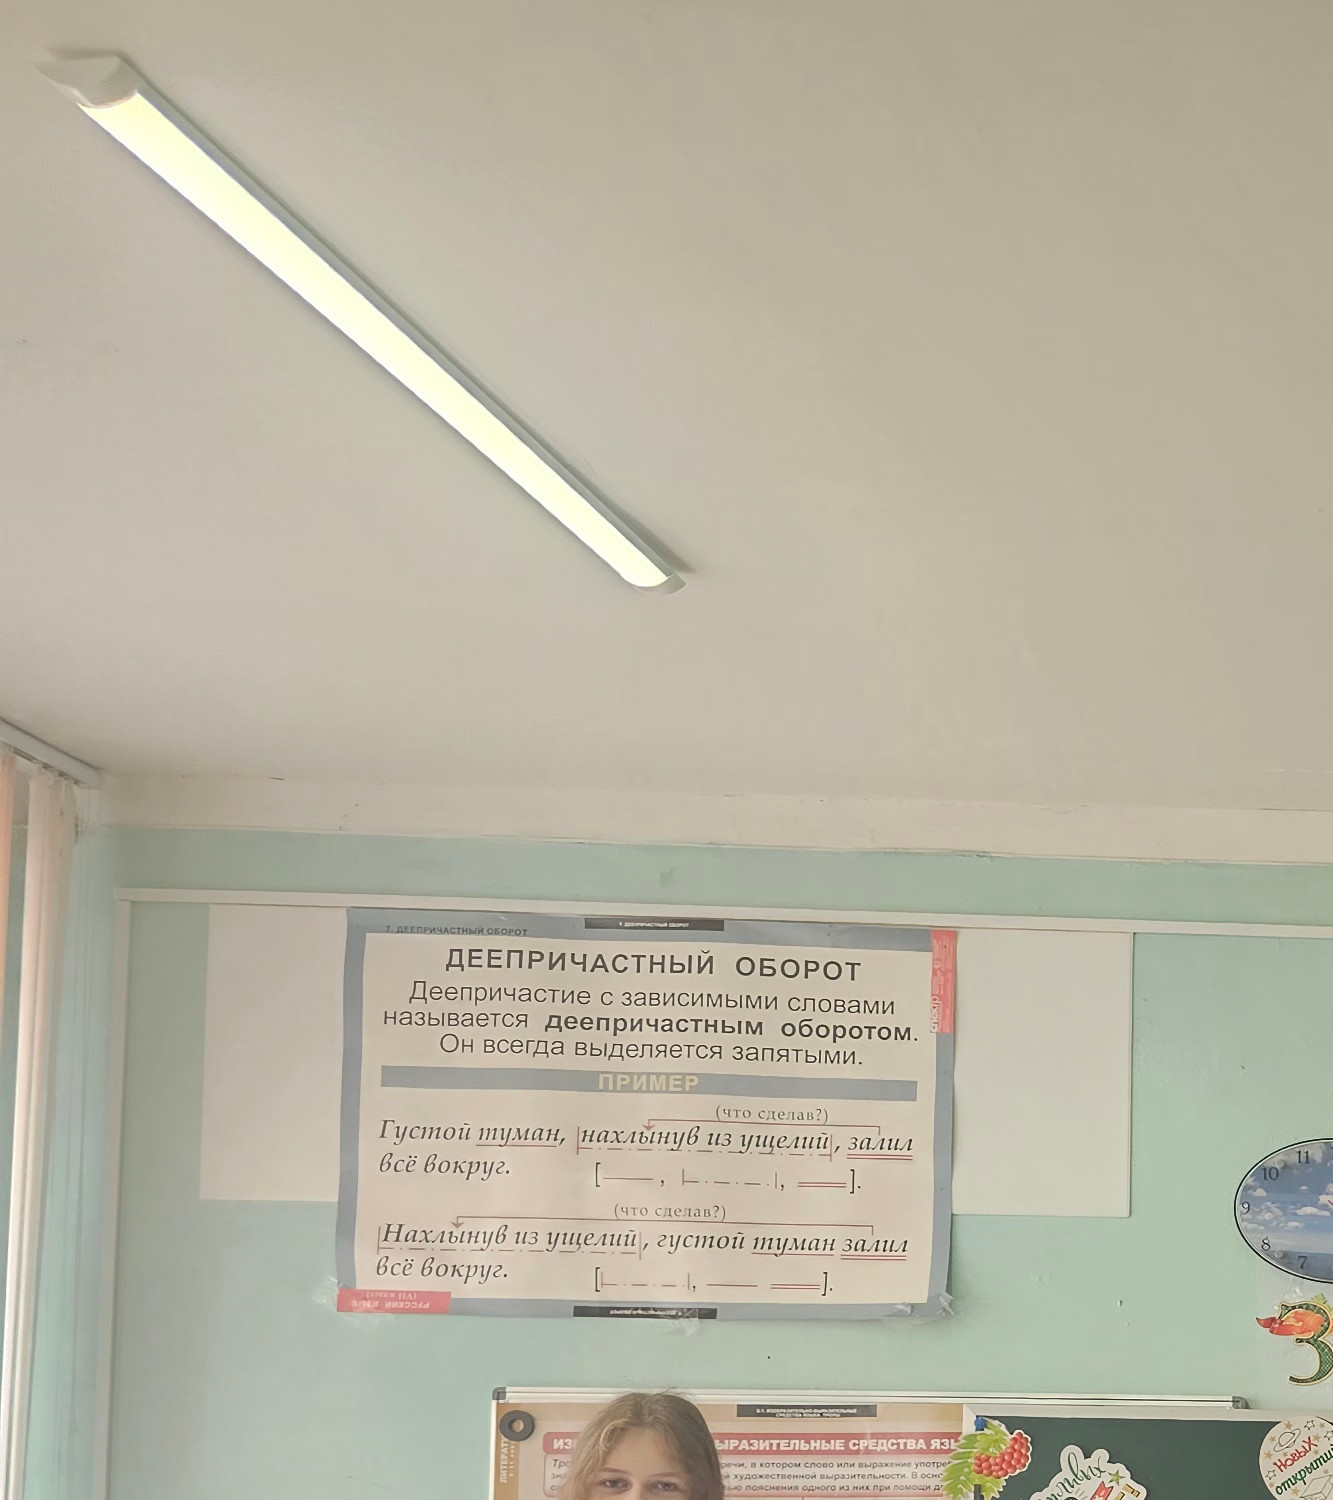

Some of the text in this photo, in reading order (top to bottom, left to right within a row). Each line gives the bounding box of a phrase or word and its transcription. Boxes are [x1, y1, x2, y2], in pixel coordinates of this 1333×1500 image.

[396, 925, 485, 936] ДЕЕПРИЧАСТНЫЙ
[486, 928, 528, 937] ОБОРОТ
[445, 948, 862, 982] ДЕЕПРИЧАСТНЫЙ ОБОРОТ
[408, 980, 895, 1016] Деепричастие с зависимыми словами
[383, 1009, 919, 1043] называется деепричастным оборотом.
[439, 1033, 863, 1066] Он всегда выделяется запятыми.
[598, 1072, 700, 1093] ПРИМЕР
[715, 1105, 829, 1125] (что сделав?)
[378, 1119, 471, 1145] Густой
[477, 1126, 567, 1147] туман,
[580, 1125, 702, 1151] нахлынув
[707, 1132, 732, 1147] из
[847, 1136, 914, 1152] залил
[1295, 1150, 1310, 1164] 11
[379, 1153, 511, 1181] всё вокруг.
[1261, 1166, 1279, 1181] 10
[613, 1203, 727, 1222] (что сделав?)
[1241, 1201, 1251, 1215] 9
[381, 1223, 509, 1251] Нахлынув
[514, 1231, 539, 1245] из
[656, 1232, 746, 1255] густой
[752, 1236, 836, 1257] туман
[842, 1238, 909, 1253] залил
[1260, 1236, 1271, 1251] 8
[376, 1256, 509, 1284] всё вокруг.
[1297, 1255, 1308, 1270] 7
[713, 1439, 846, 1451] ЫРАЗИТЕЛЬНЫЕ
[848, 1438, 928, 1452] СРЕДСТВА
[759, 1461, 801, 1470] котором
[803, 1461, 835, 1469] слово
[836, 1461, 855, 1469] или
[857, 1461, 912, 1470] выражение
[733, 1472, 817, 1481] художественной
[819, 1472, 908, 1481] выразительности.
[911, 1472, 918, 1480] В
[801, 1485, 837, 1493] одного
[852, 1484, 870, 1492] них
[873, 1484, 891, 1493] при
[893, 1484, 931, 1493] помощи
